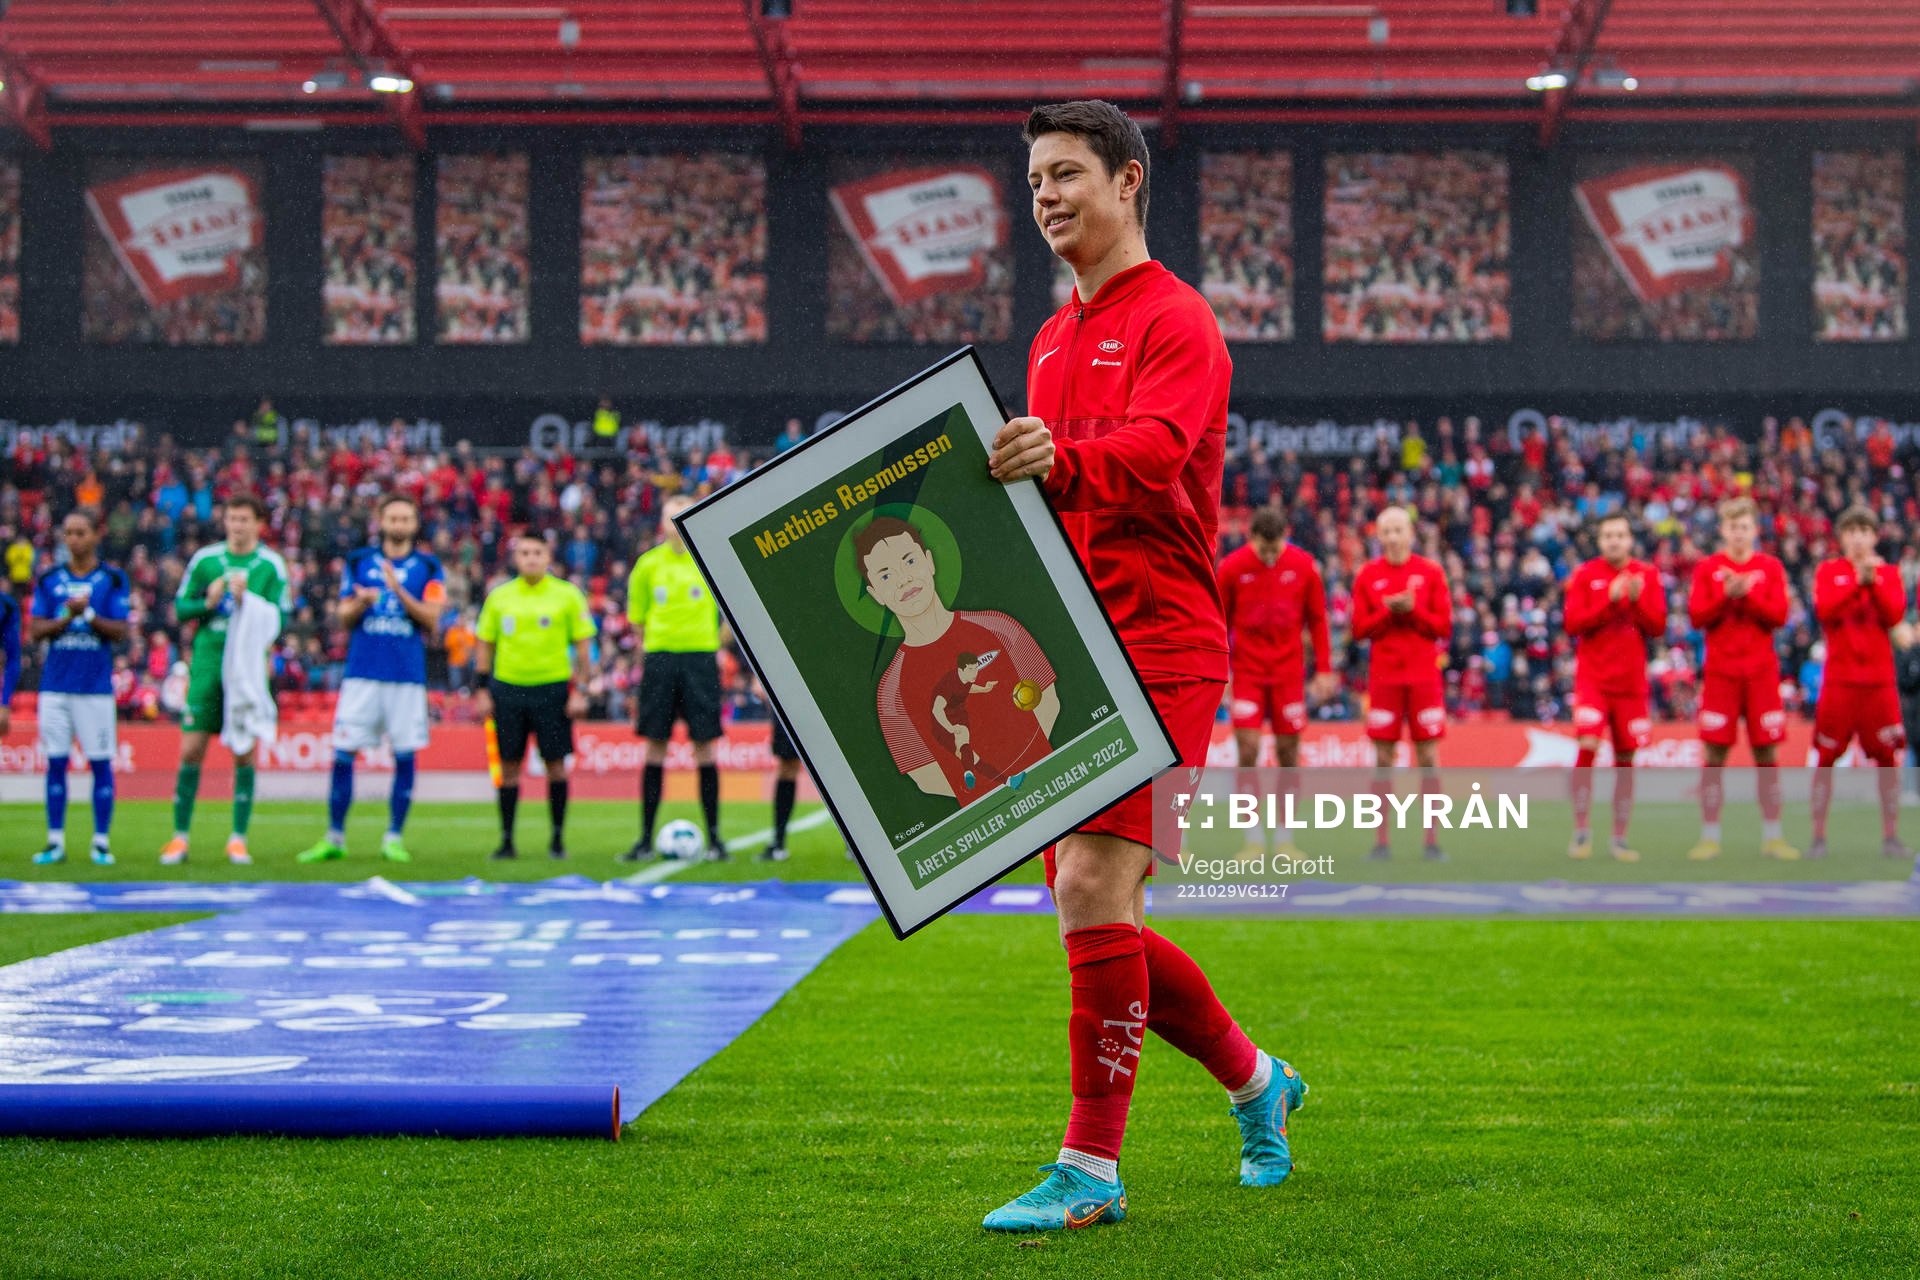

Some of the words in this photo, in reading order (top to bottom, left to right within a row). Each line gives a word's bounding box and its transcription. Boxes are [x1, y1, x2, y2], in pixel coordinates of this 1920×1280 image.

[753, 501, 839, 559] Mathias
[836, 433, 953, 511] Rasmussen
[1091, 704, 1109, 720] NTB
[905, 821, 925, 836] OBOS
[915, 844, 957, 880] ÅRETS
[955, 814, 1008, 854] SPILLER
[1010, 761, 1089, 820] OBOS-LIGAEN
[1092, 737, 1128, 769] 2022
[1097, 1000, 1147, 1084] tide
